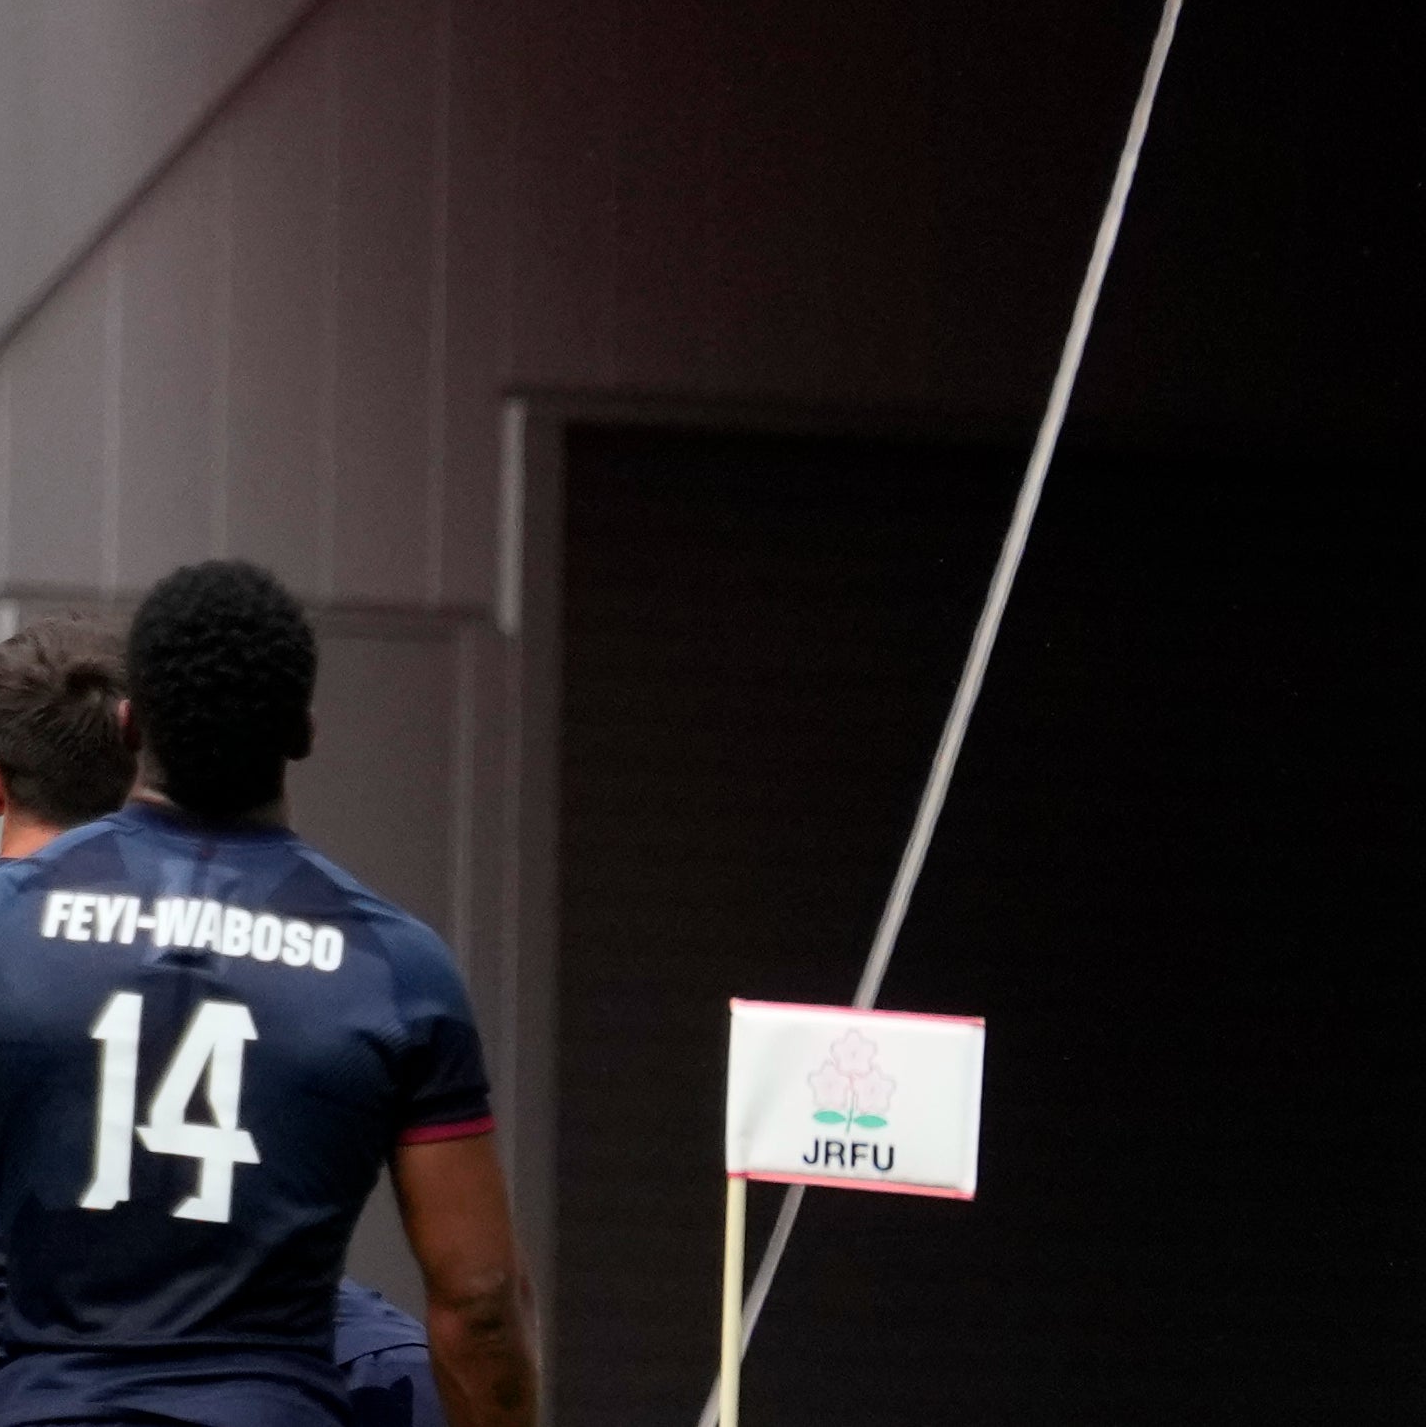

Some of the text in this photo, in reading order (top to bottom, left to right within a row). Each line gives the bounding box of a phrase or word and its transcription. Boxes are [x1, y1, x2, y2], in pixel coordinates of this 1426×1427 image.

[41, 890, 345, 972] FEYI-WABOSO
[80, 991, 260, 1223] 14
[803, 1138, 896, 1172] JRFU
